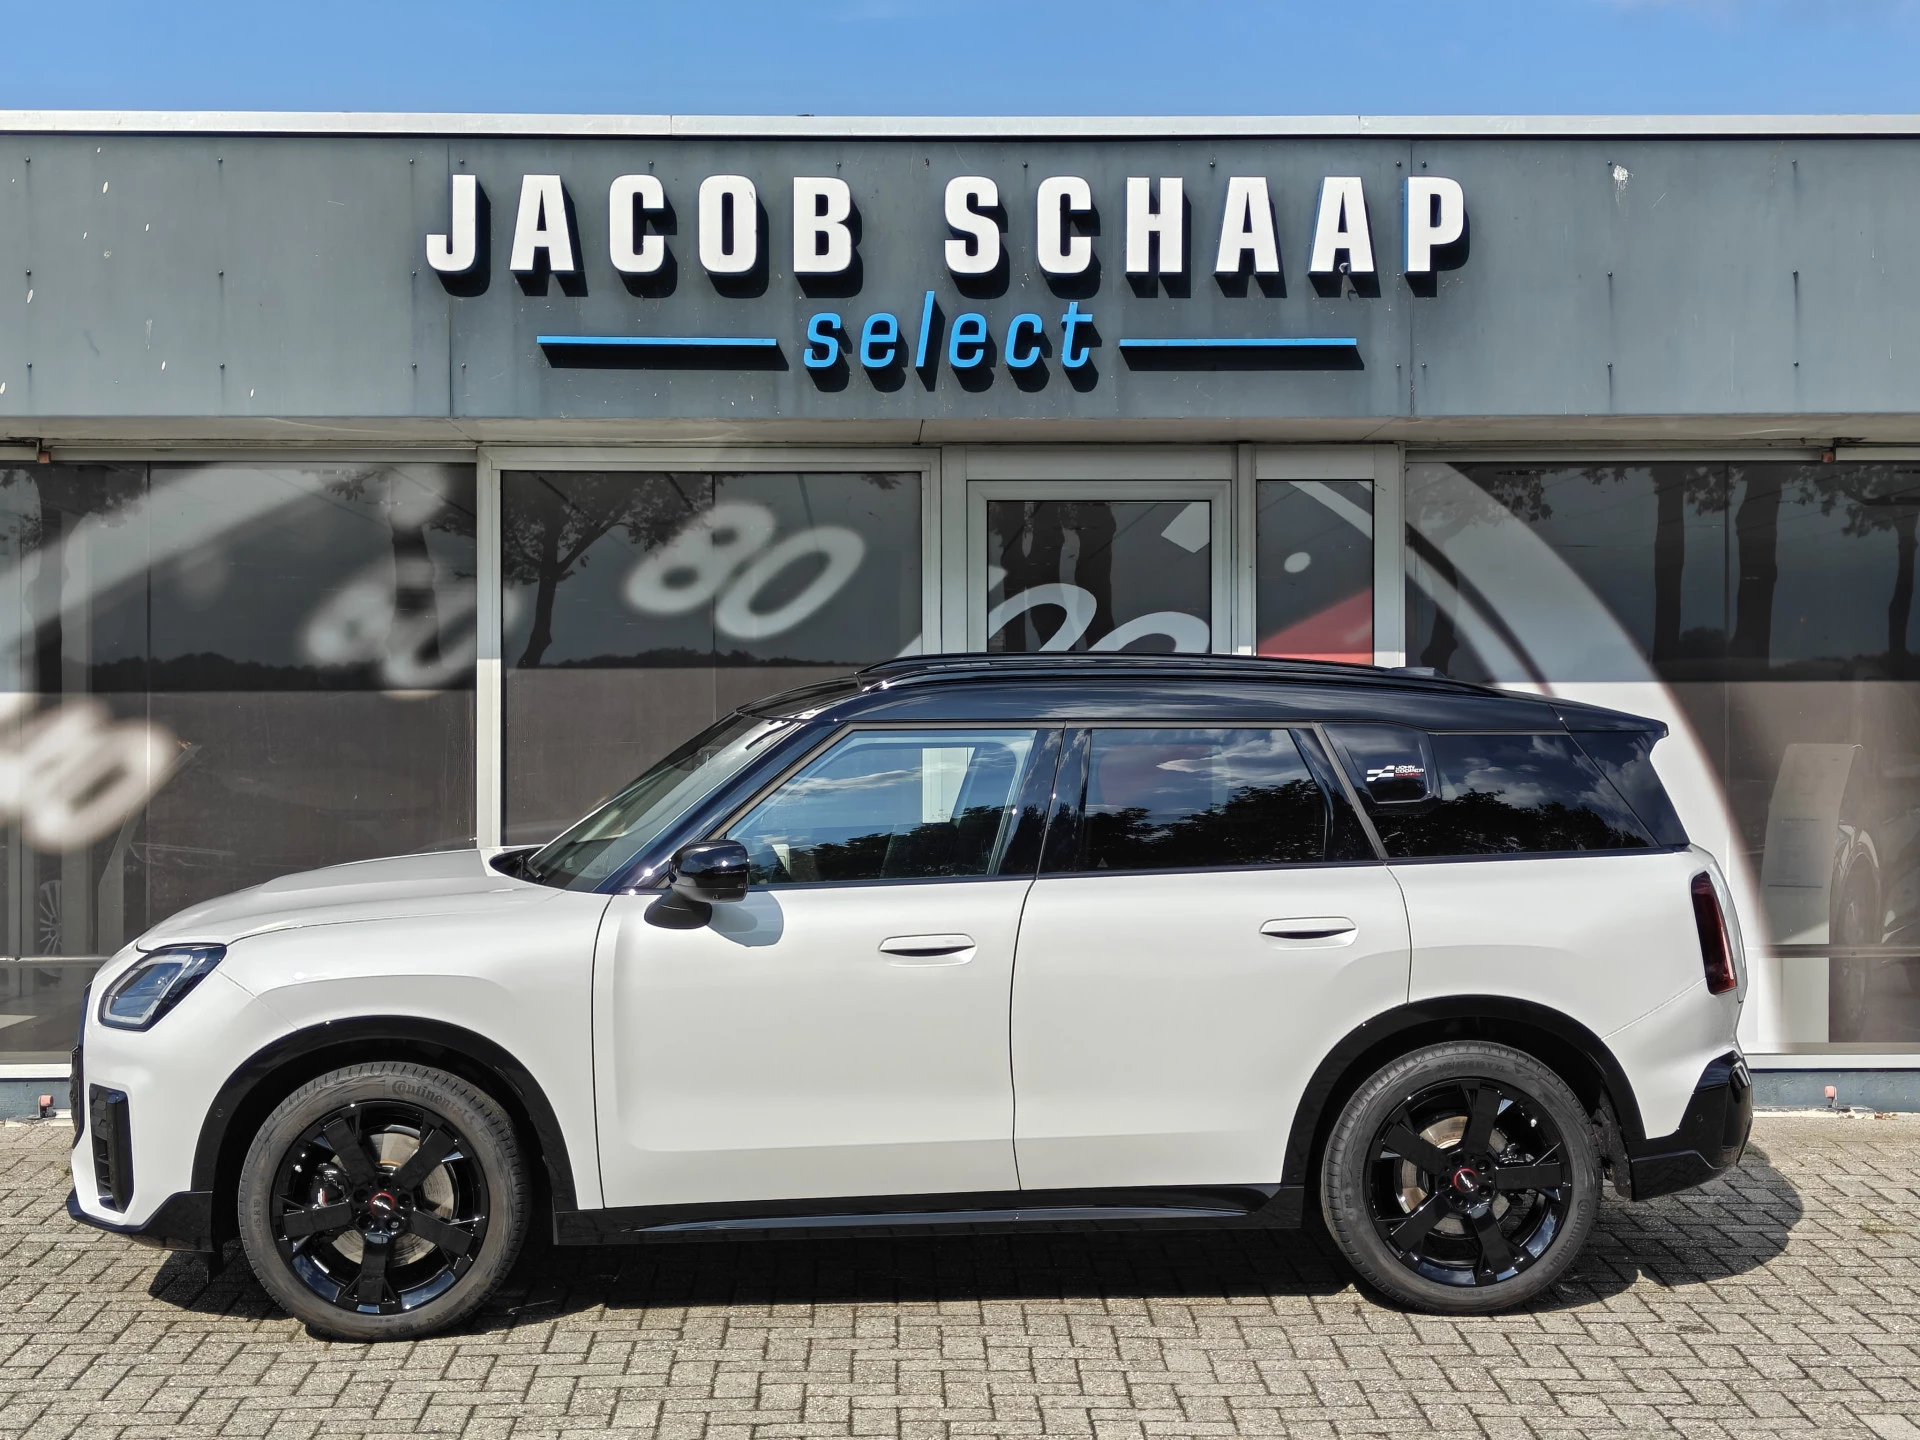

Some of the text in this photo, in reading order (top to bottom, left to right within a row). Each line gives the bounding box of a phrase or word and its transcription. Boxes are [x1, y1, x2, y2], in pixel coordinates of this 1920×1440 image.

[426, 173, 1464, 274] JACOB SCHAAP
[803, 290, 1093, 368] select
[624, 502, 867, 640] 80
